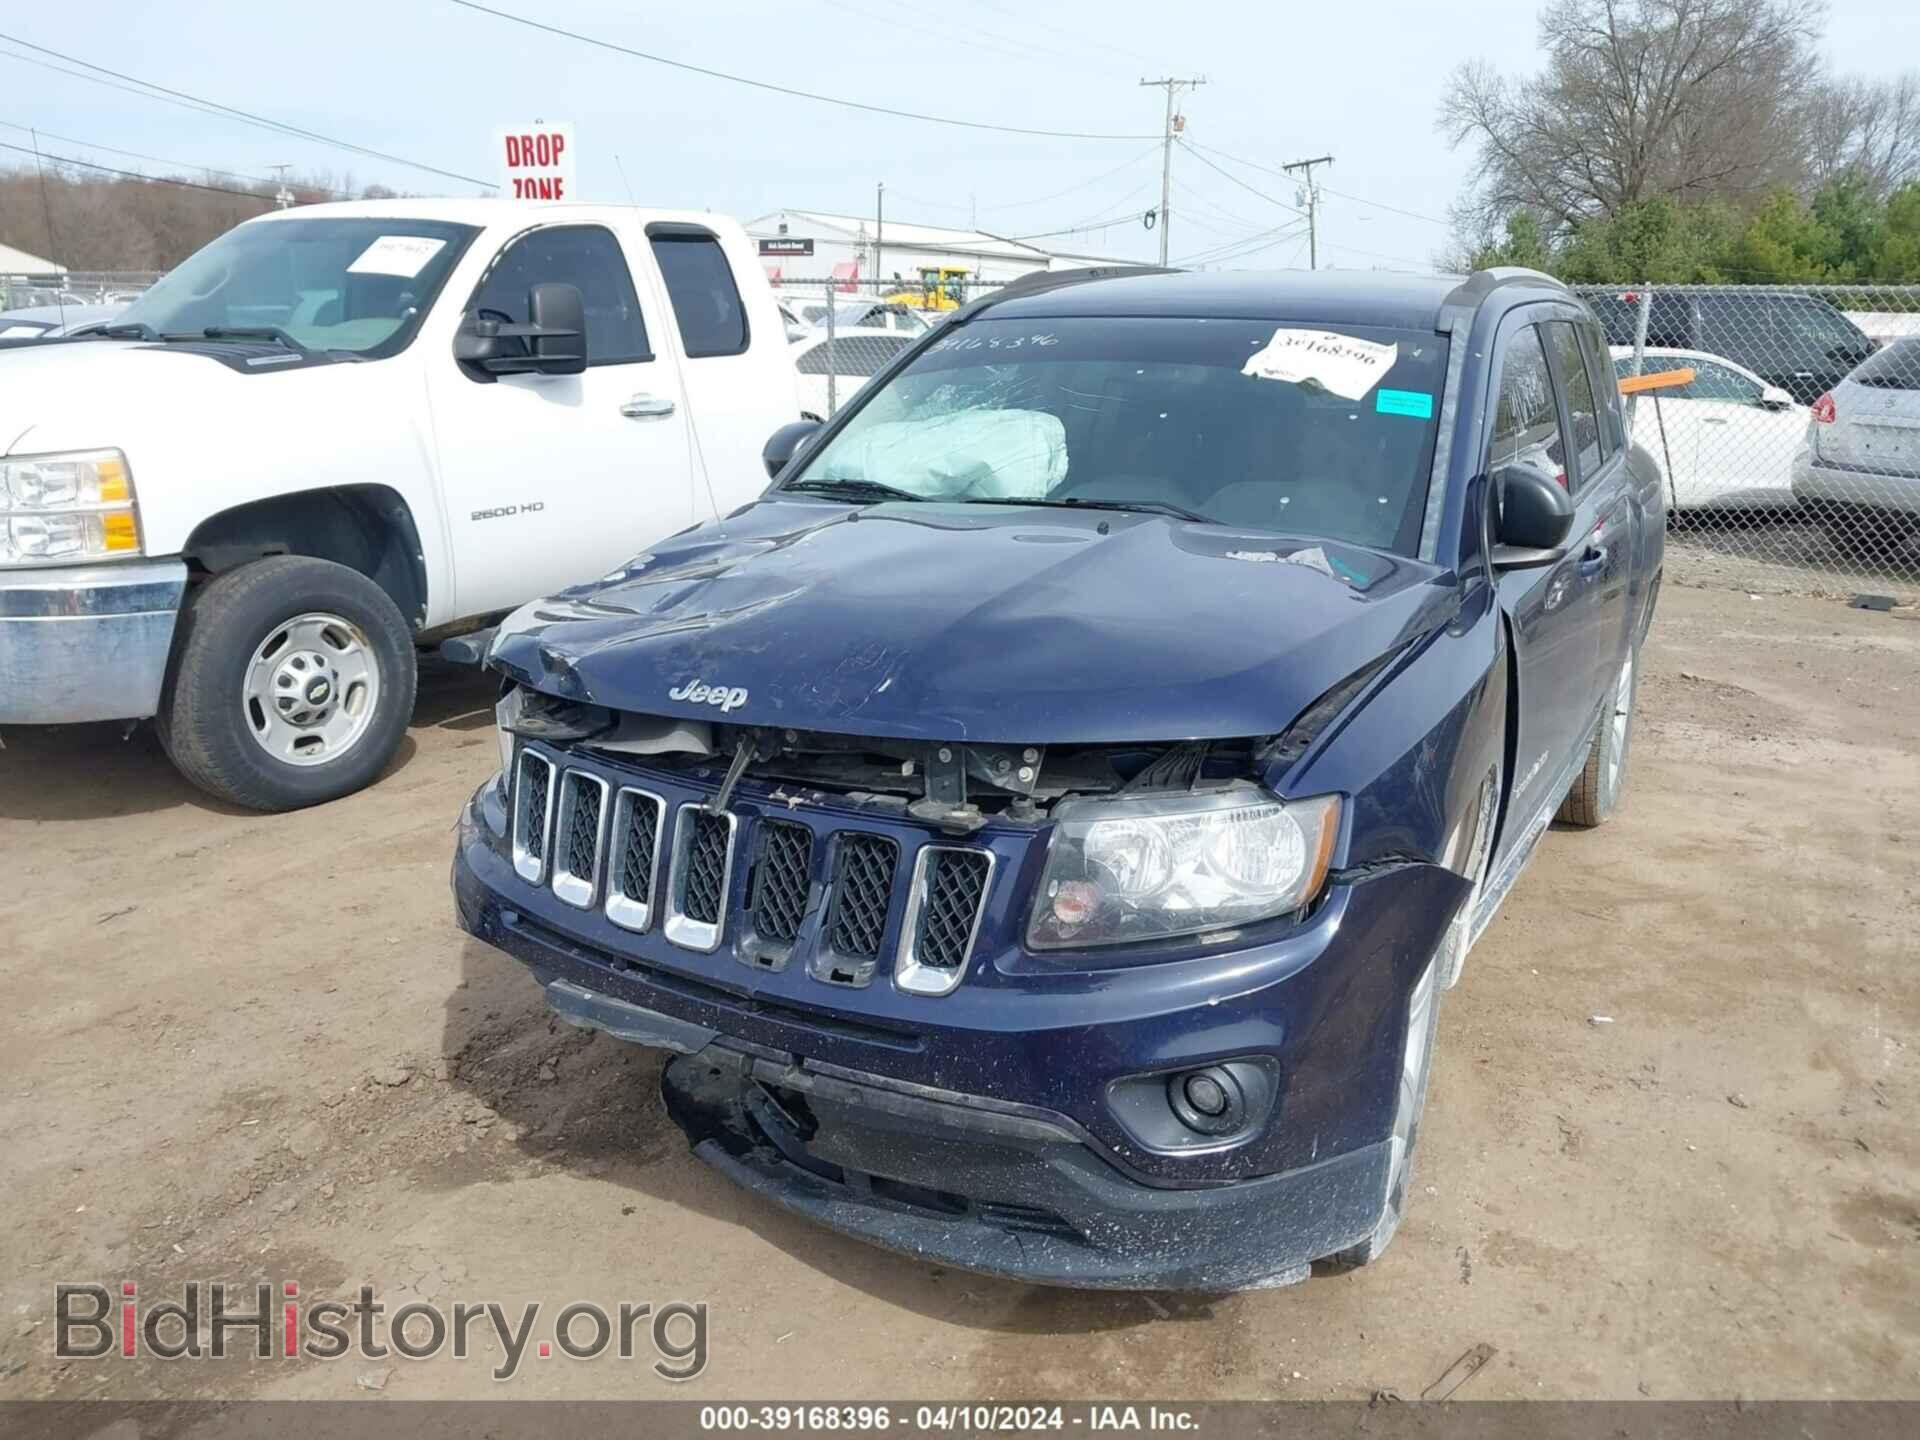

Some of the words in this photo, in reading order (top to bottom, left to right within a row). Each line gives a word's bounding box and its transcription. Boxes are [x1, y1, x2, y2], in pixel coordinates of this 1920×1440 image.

[505, 133, 565, 167] DROP
[512, 177, 564, 200] ZONE
[520, 501, 545, 513] HD
[668, 679, 749, 713] Jeep
